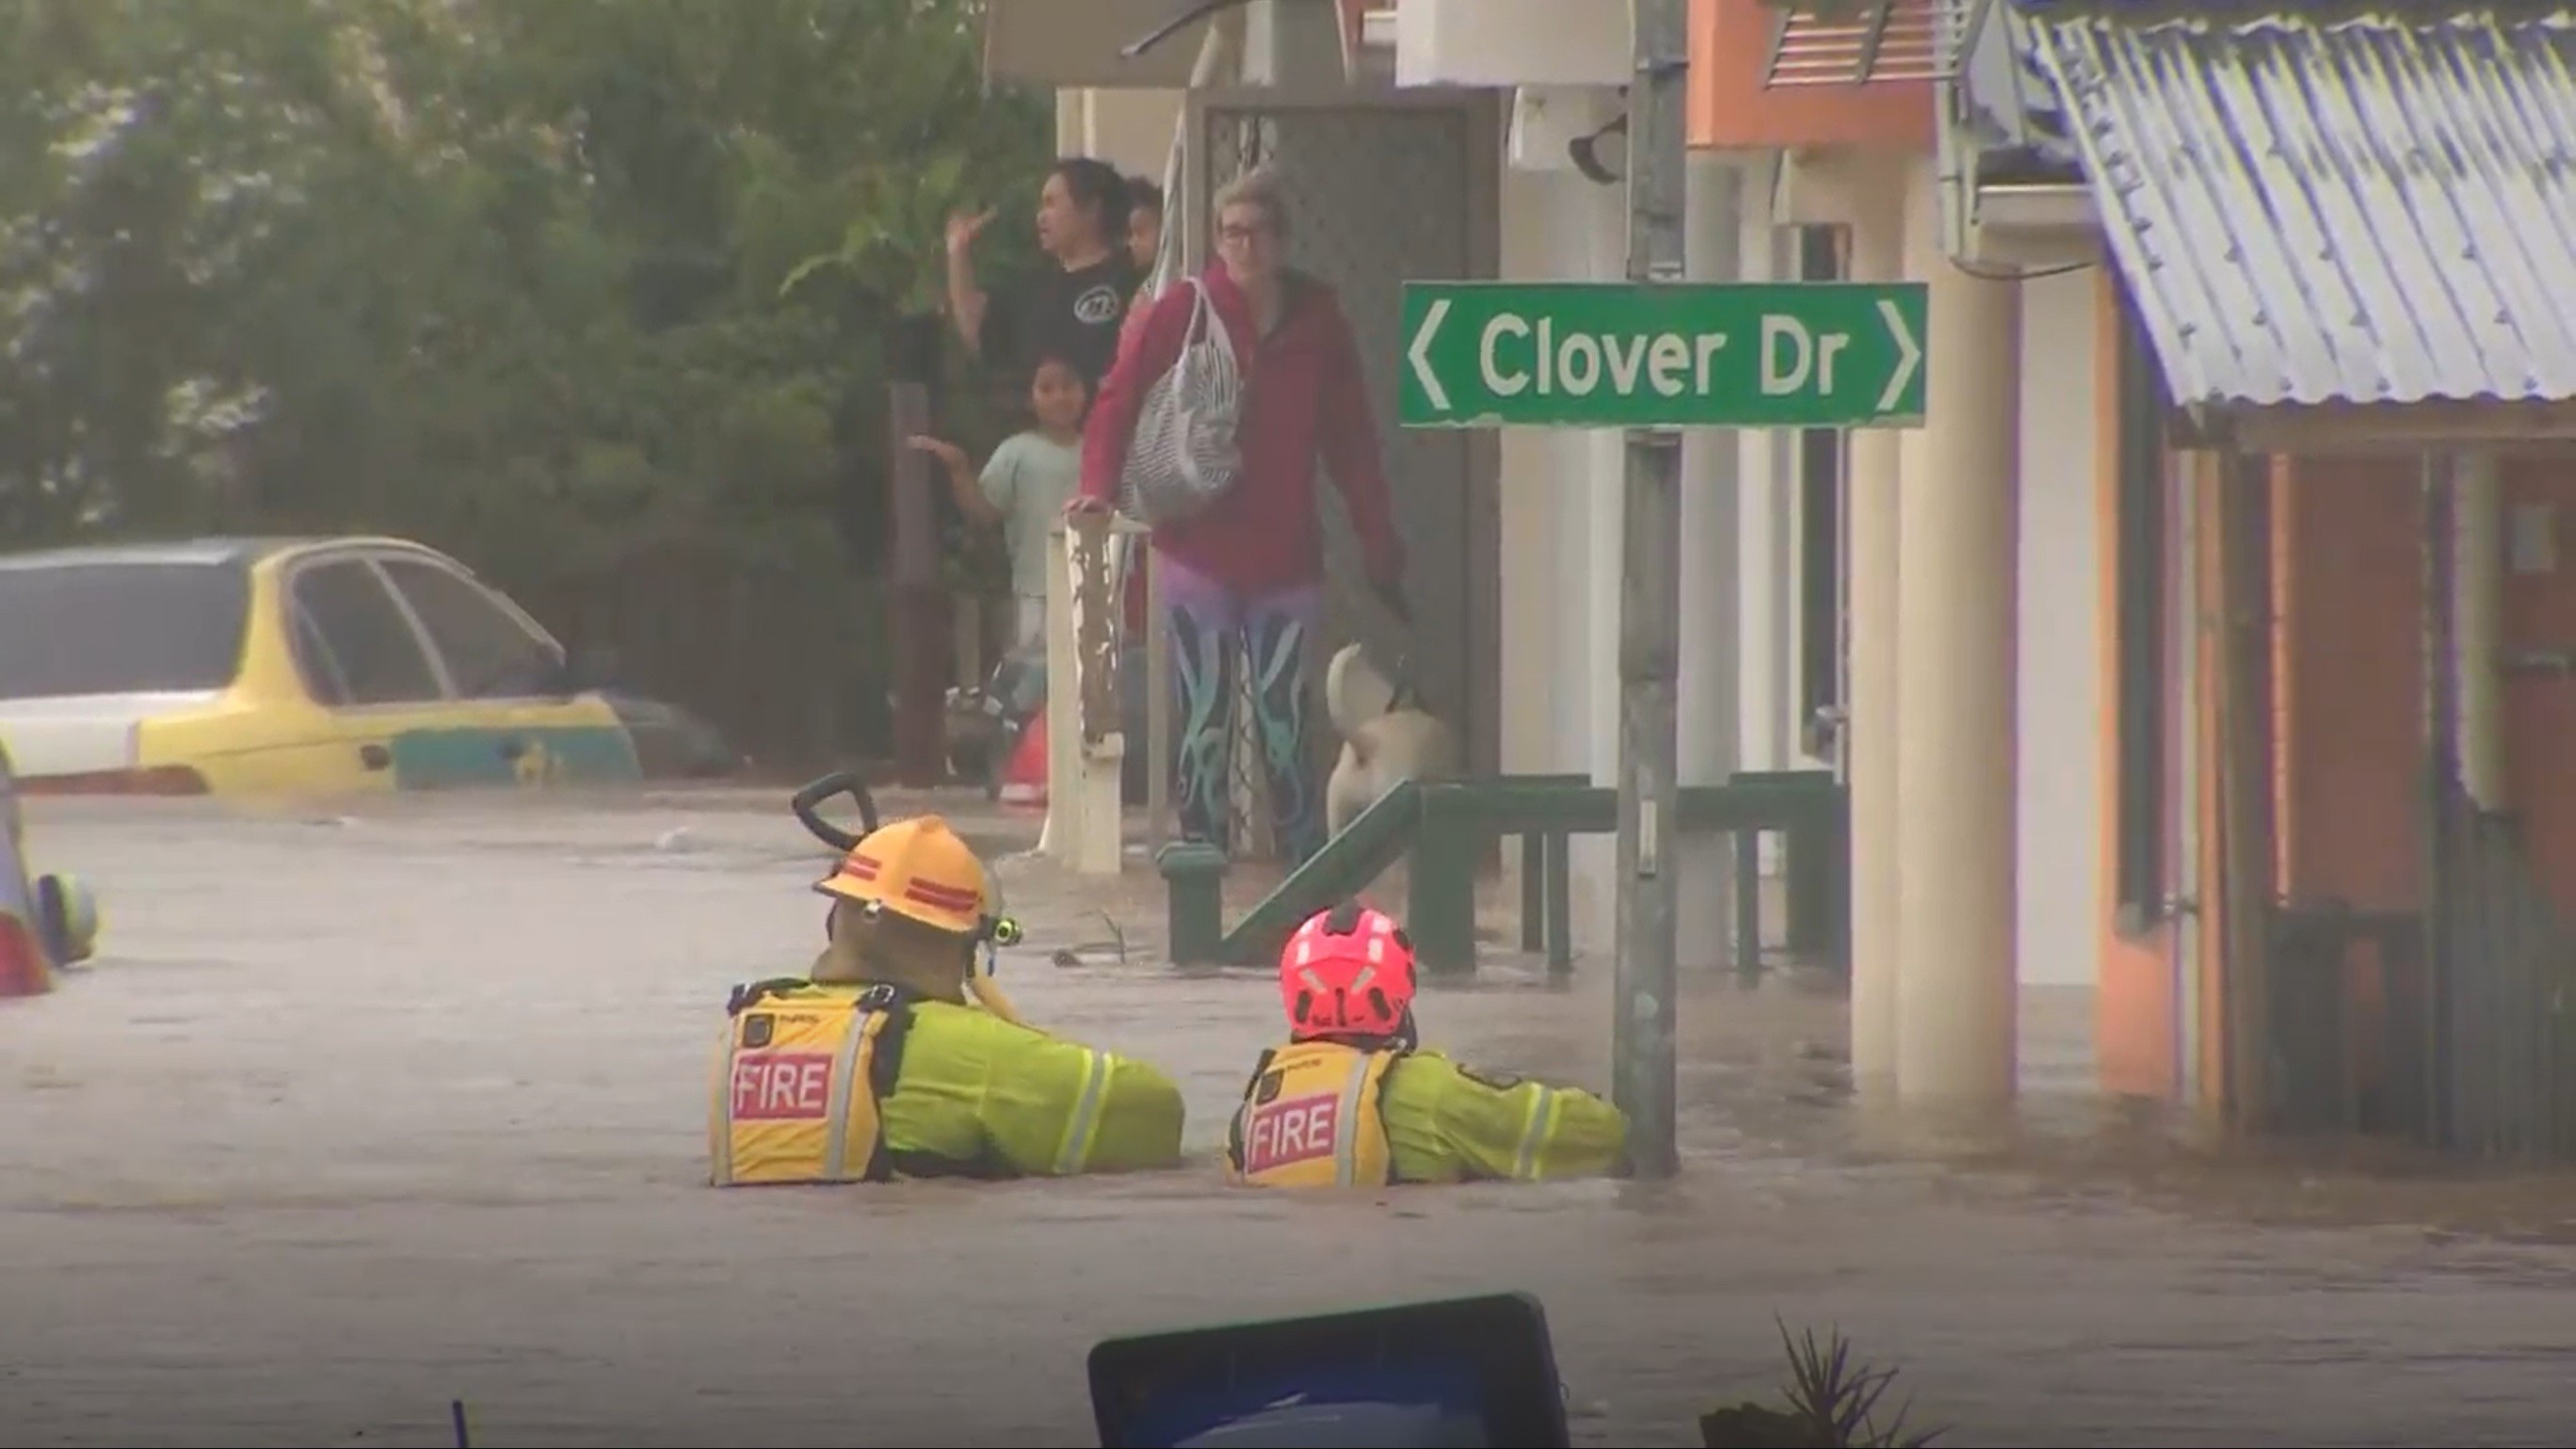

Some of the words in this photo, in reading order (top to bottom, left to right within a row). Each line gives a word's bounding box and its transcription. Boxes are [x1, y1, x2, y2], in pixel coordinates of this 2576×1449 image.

[1479, 312, 1728, 396] Clover
[1760, 314, 1851, 396] Dr
[737, 1062, 827, 1110] FIRE
[1250, 1103, 1333, 1166] FIRE
